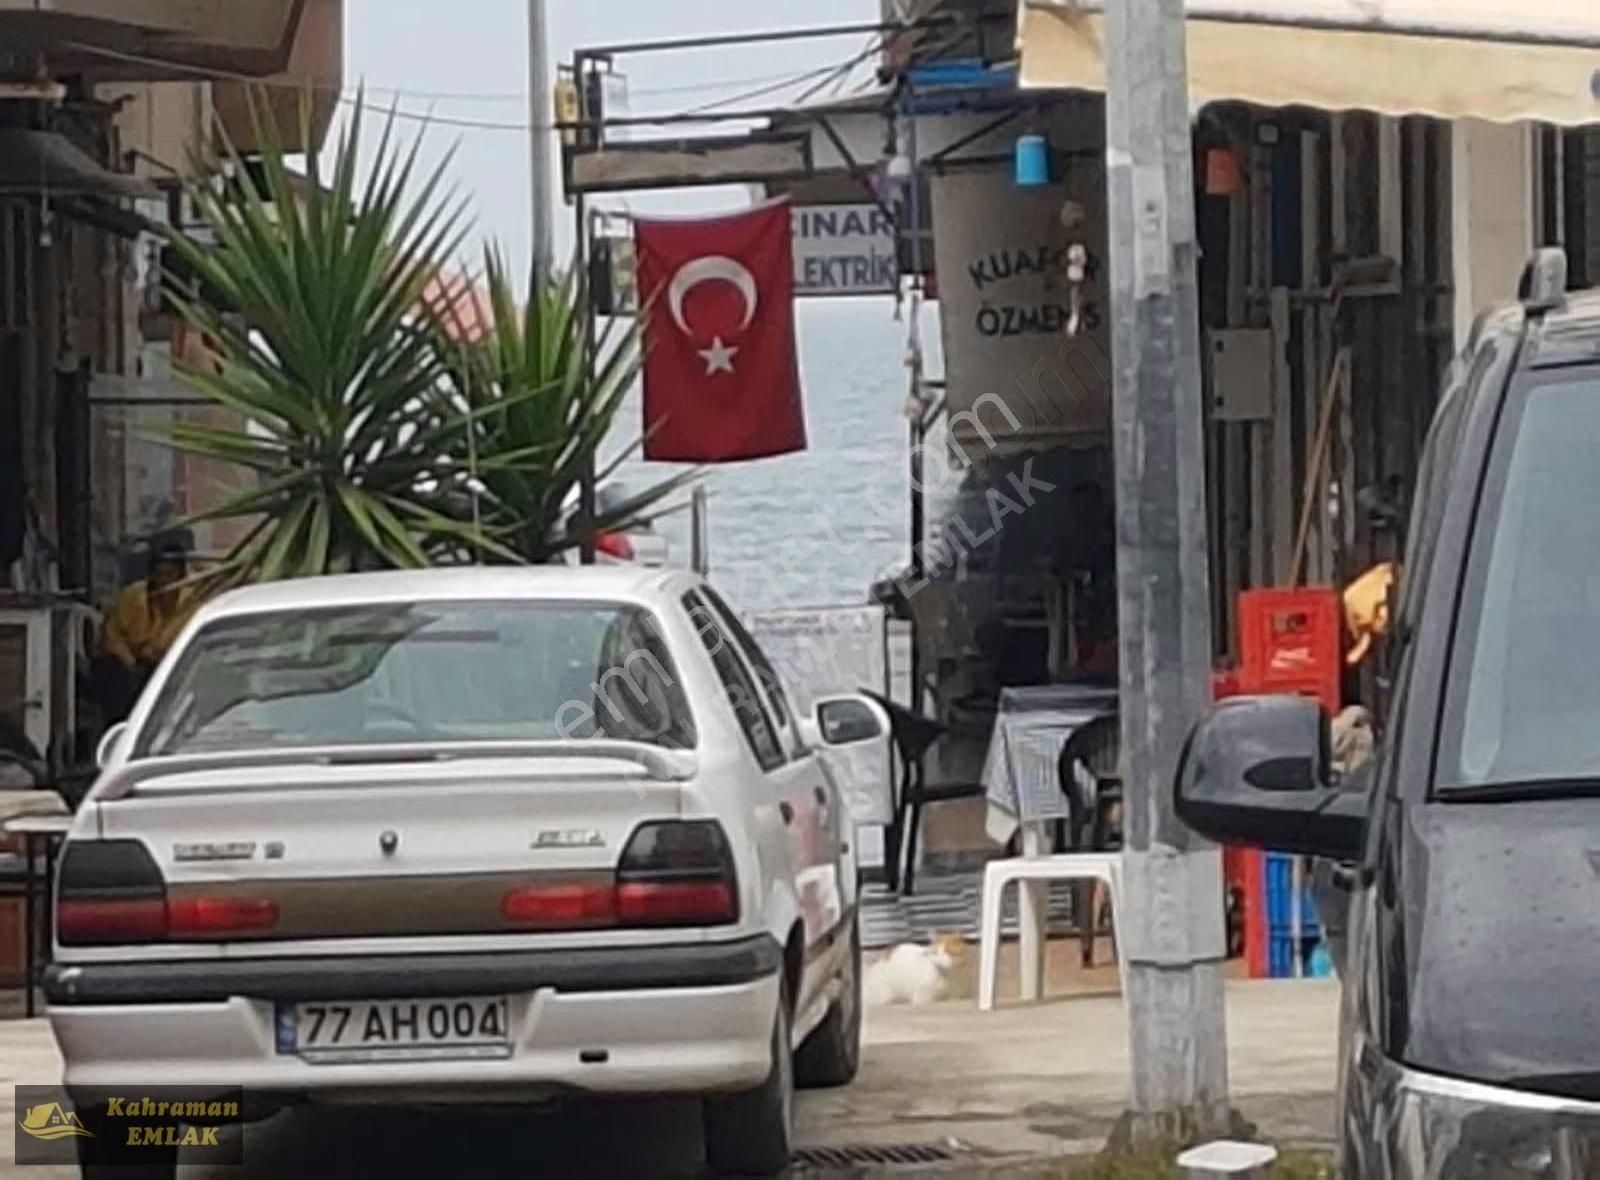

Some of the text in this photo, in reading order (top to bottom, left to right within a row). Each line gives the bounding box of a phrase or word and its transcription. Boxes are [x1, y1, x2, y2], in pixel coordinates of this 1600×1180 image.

[793, 210, 894, 238] INAR
[304, 1007, 351, 1044] 77
[363, 1005, 418, 1041] AH
[428, 1002, 501, 1039] 004
